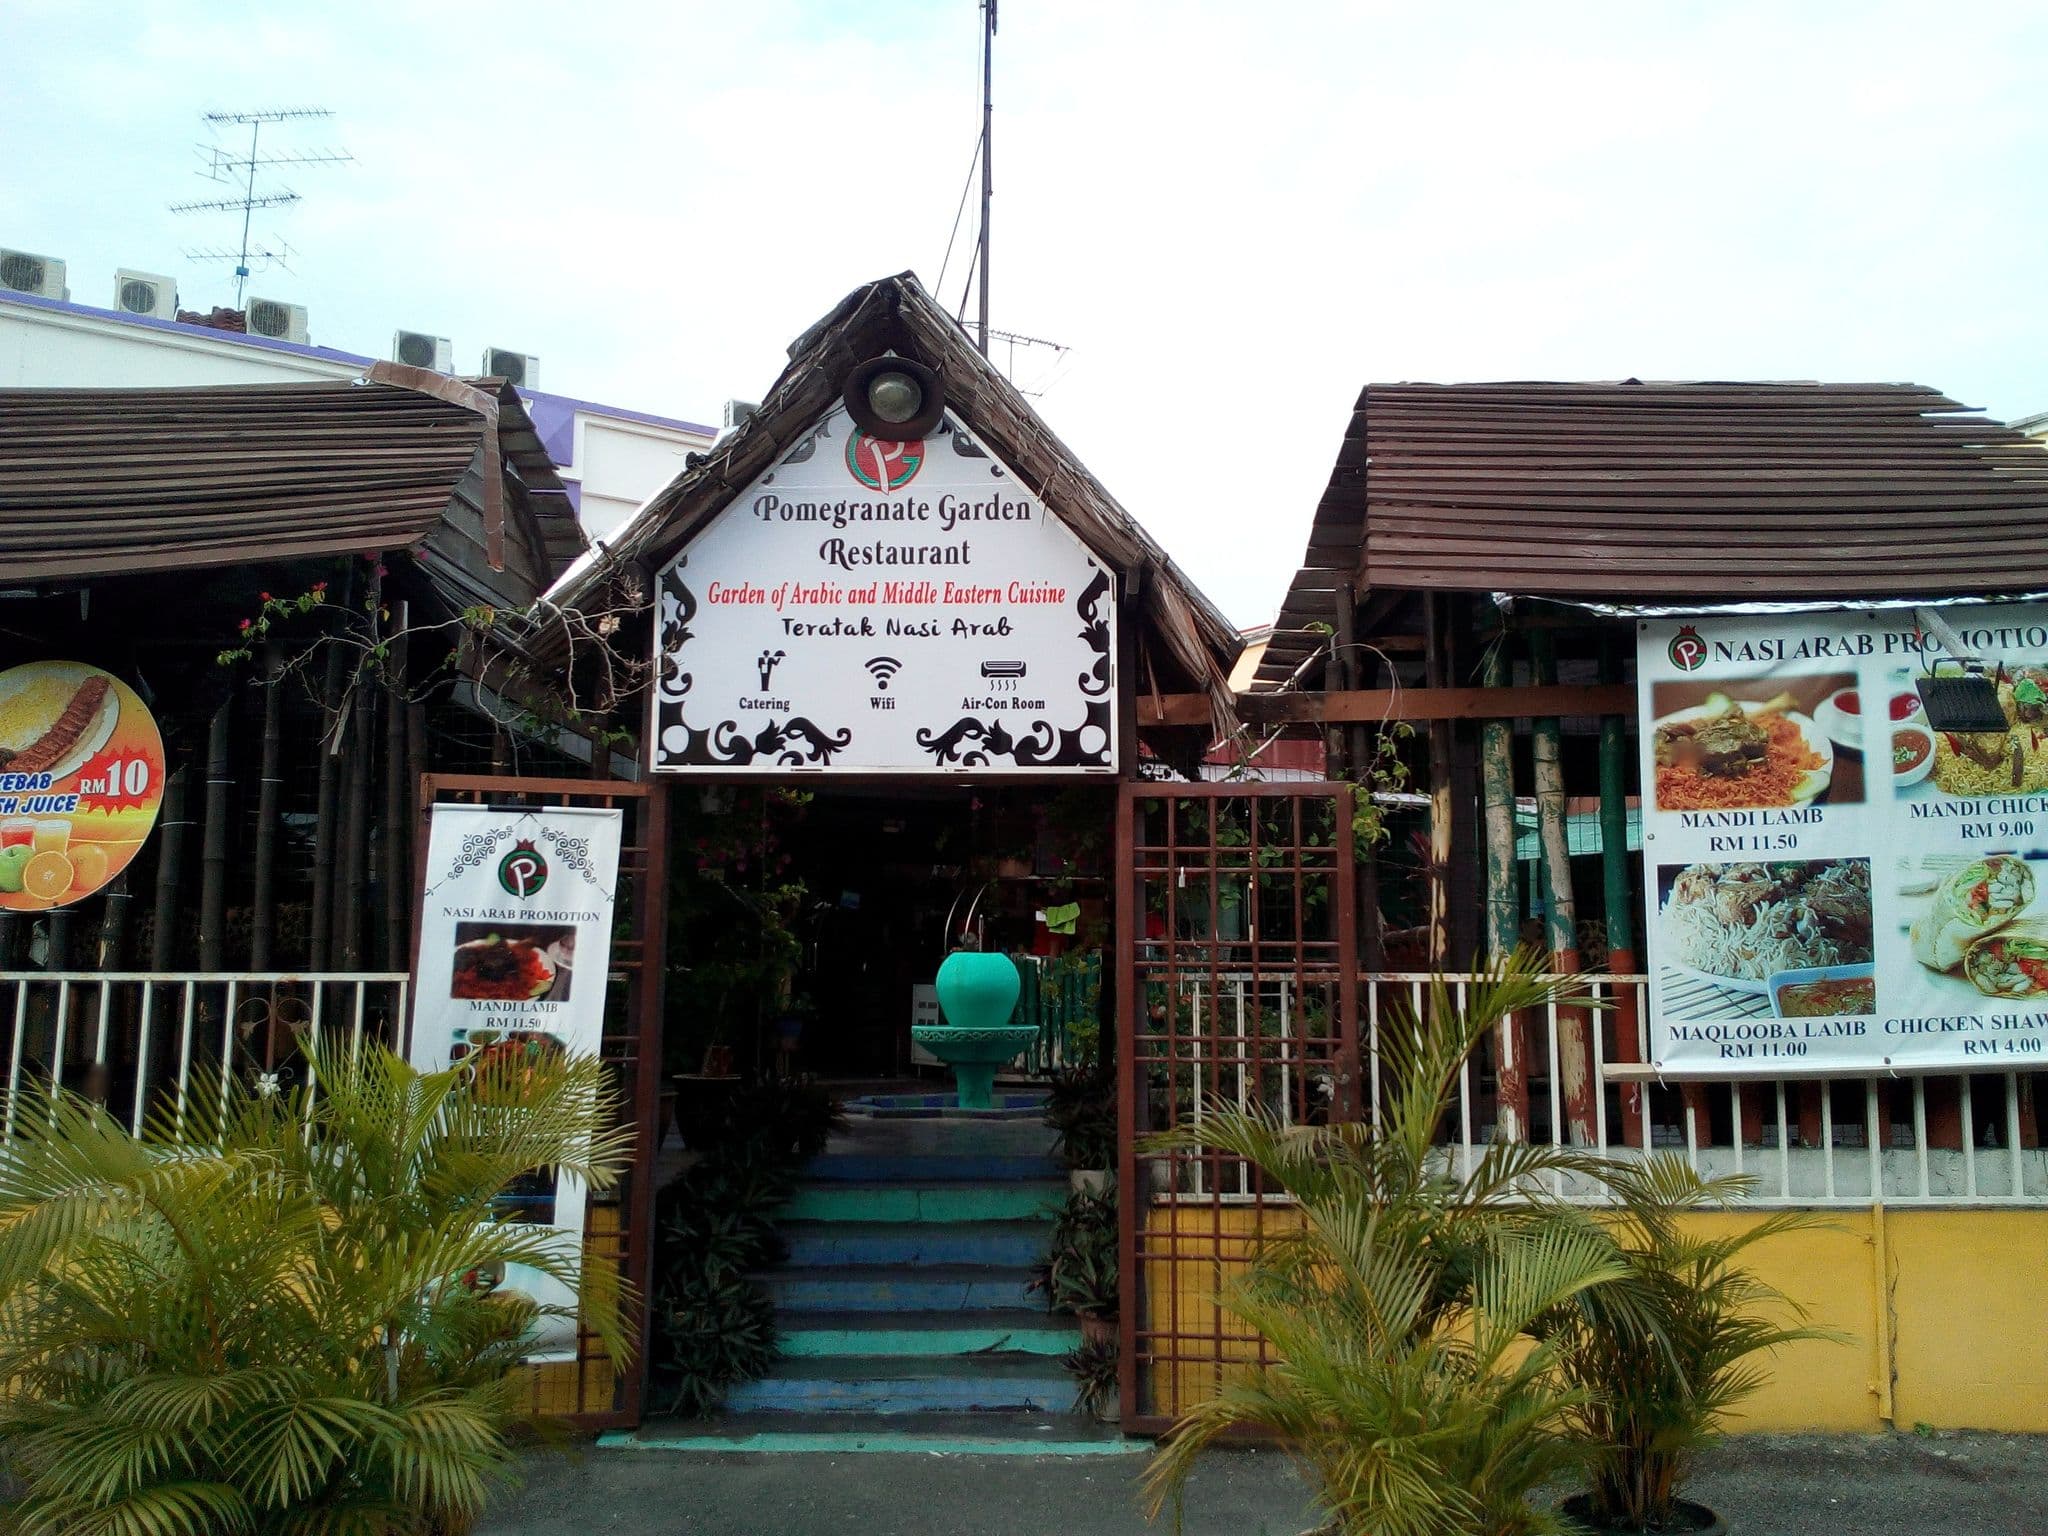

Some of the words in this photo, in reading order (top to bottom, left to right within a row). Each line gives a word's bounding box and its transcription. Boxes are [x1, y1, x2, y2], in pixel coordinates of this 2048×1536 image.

[753, 495, 930, 529] Pomegranate
[938, 493, 1032, 531] Garden
[819, 537, 971, 571] Restaurant
[708, 581, 765, 604] Garden
[771, 582, 788, 612] of
[790, 582, 843, 605] Arabic
[848, 583, 877, 605] and
[883, 582, 938, 605] Middle
[943, 582, 1002, 605] Eastern
[1008, 582, 1066, 605] Cuisine
[781, 617, 876, 638] Teratak
[886, 618, 942, 637] Nasi
[952, 616, 1014, 638] Arab
[1713, 637, 1784, 663] NASI
[1793, 630, 1874, 659] ARAB
[1883, 626, 2048, 654] PROOTIO
[739, 697, 791, 712] Catering
[870, 697, 896, 710] Wifi
[961, 697, 1007, 711] Air-Con
[1011, 697, 1046, 710] Room
[20, 794, 79, 814] JUICE
[1910, 800, 1981, 819] MANDI
[1681, 811, 1757, 829] MANDI
[1762, 807, 1823, 825] LAMB
[1961, 822, 1993, 839] RM
[1999, 820, 2034, 837] 9.00
[1709, 836, 1745, 852] RM
[1752, 834, 1798, 851] 11.50
[443, 907, 475, 918] NASI
[478, 909, 516, 920] ARAB
[519, 910, 601, 922] PROMOTION
[470, 1001, 518, 1013] MANDI
[520, 1003, 559, 1014] LAMB
[486, 1017, 509, 1029] RM
[512, 1017, 542, 1029] 11.50
[1669, 1024, 1799, 1045] MAQLOOBA
[1804, 1020, 1866, 1038] LAMB
[1884, 1016, 1984, 1035] CHICKEN
[1719, 1043, 1755, 1058] RM
[1761, 1042, 1808, 1058] 11.00
[1963, 1039, 1998, 1055] RM
[2004, 1037, 2042, 1053] 4.00
